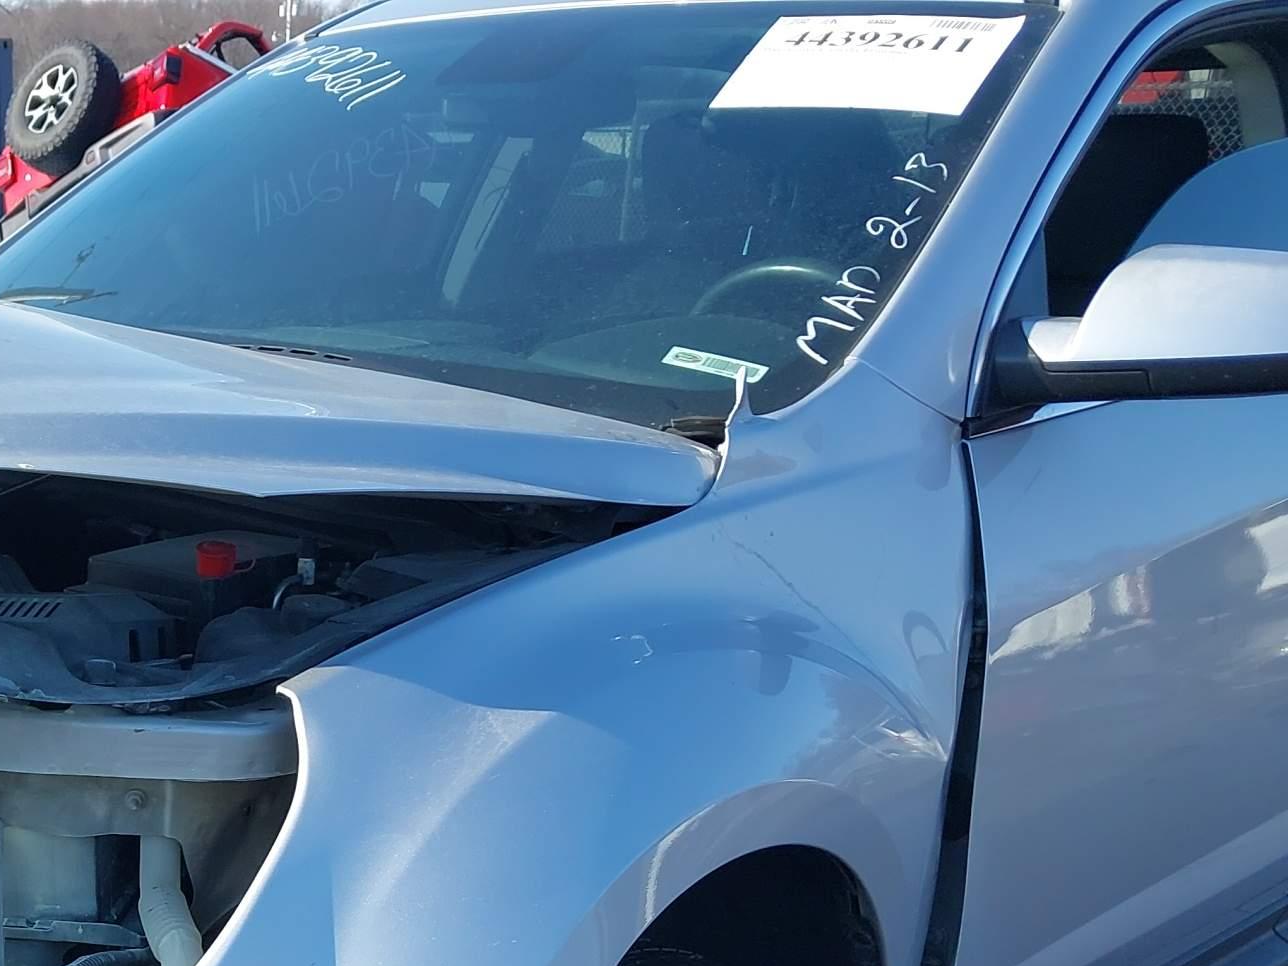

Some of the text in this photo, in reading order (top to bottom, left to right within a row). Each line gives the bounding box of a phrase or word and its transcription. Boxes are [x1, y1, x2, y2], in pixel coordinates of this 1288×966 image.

[784, 31, 973, 53] 44392611
[796, 152, 948, 365] MAD 2-13
